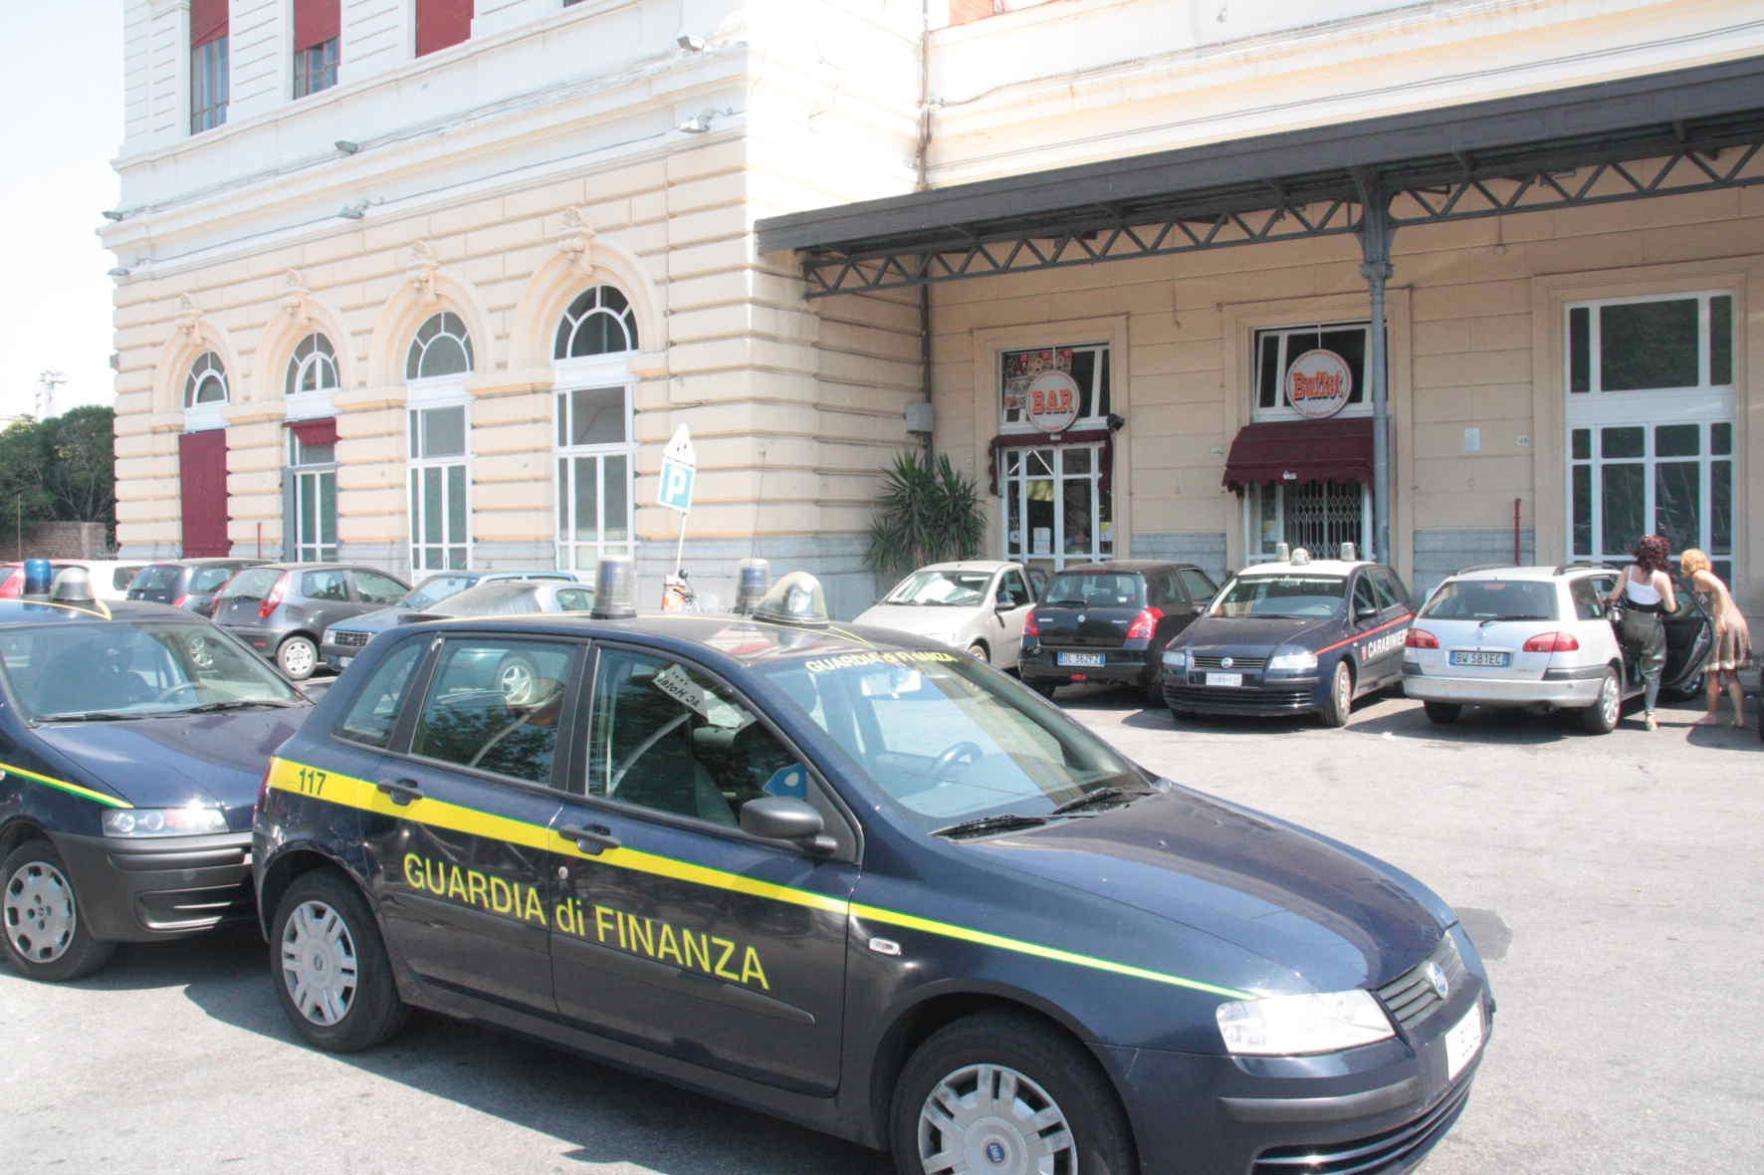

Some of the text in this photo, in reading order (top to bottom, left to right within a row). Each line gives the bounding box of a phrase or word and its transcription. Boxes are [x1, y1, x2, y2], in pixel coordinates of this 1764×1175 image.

[1031, 388, 1074, 414] BAR
[665, 467, 688, 502] P
[299, 767, 326, 795] 117
[403, 853, 770, 990] GUARDIA di FINANZA
